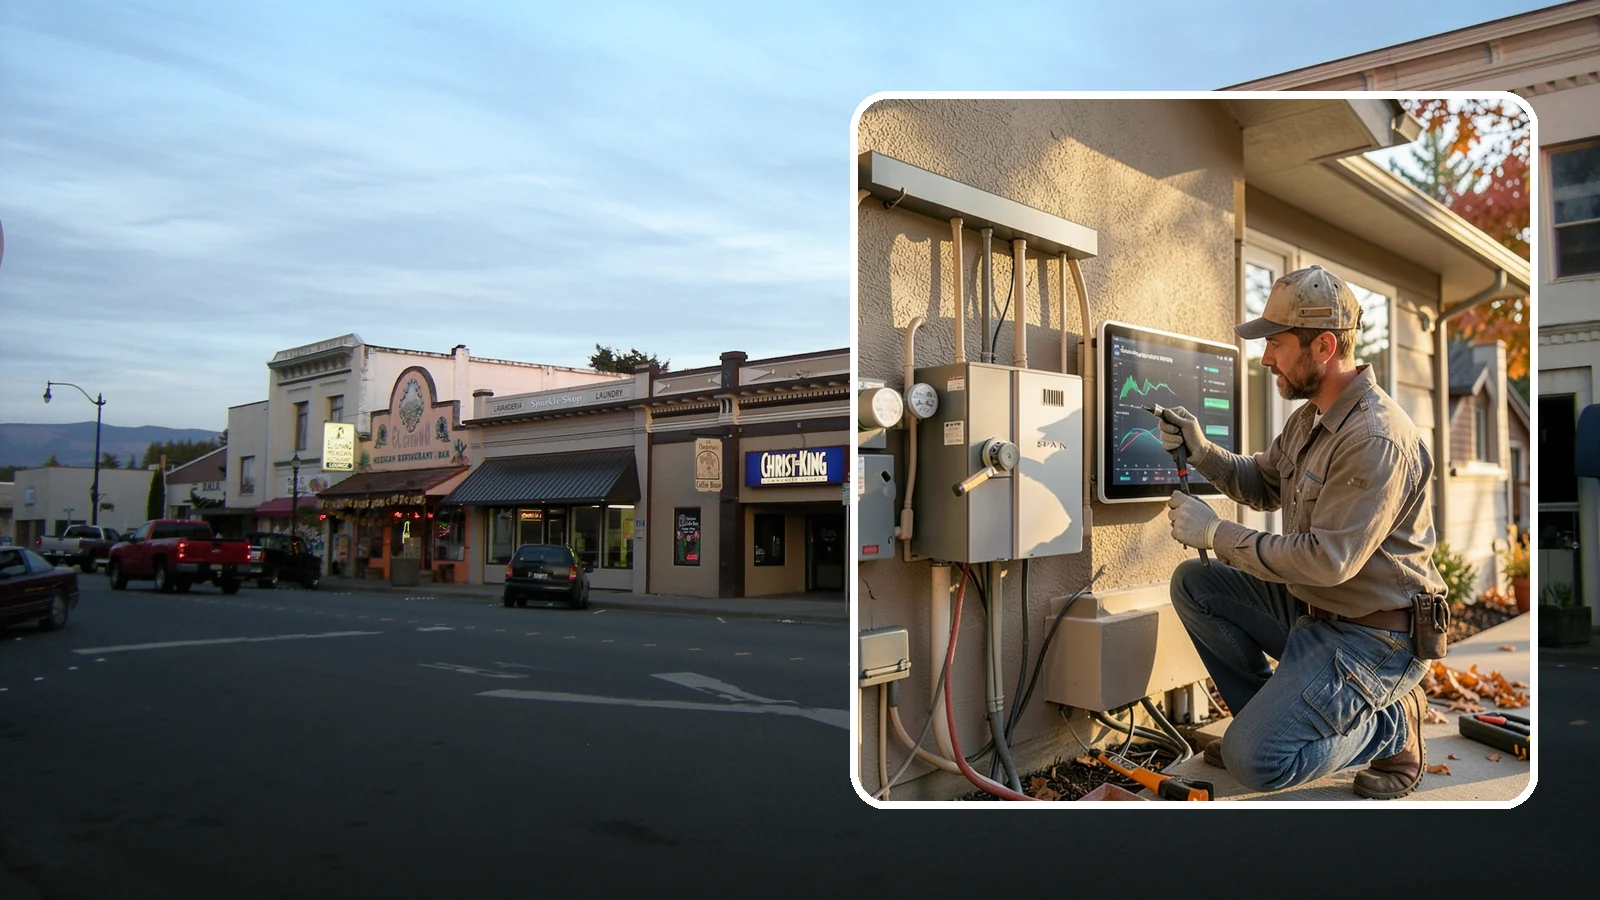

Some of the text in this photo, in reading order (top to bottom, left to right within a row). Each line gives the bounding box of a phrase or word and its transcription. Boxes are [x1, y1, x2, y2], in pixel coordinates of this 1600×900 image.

[595, 389, 624, 400] LAUNDRY
[493, 401, 522, 413] LAVANDERIA
[530, 394, 582, 409] Sparkle Shop
[373, 450, 450, 464] MEXICAN RESTAURANT BAR
[761, 452, 797, 478] CHRIST
[799, 449, 828, 477] KING
[697, 480, 722, 489] Coffee House
